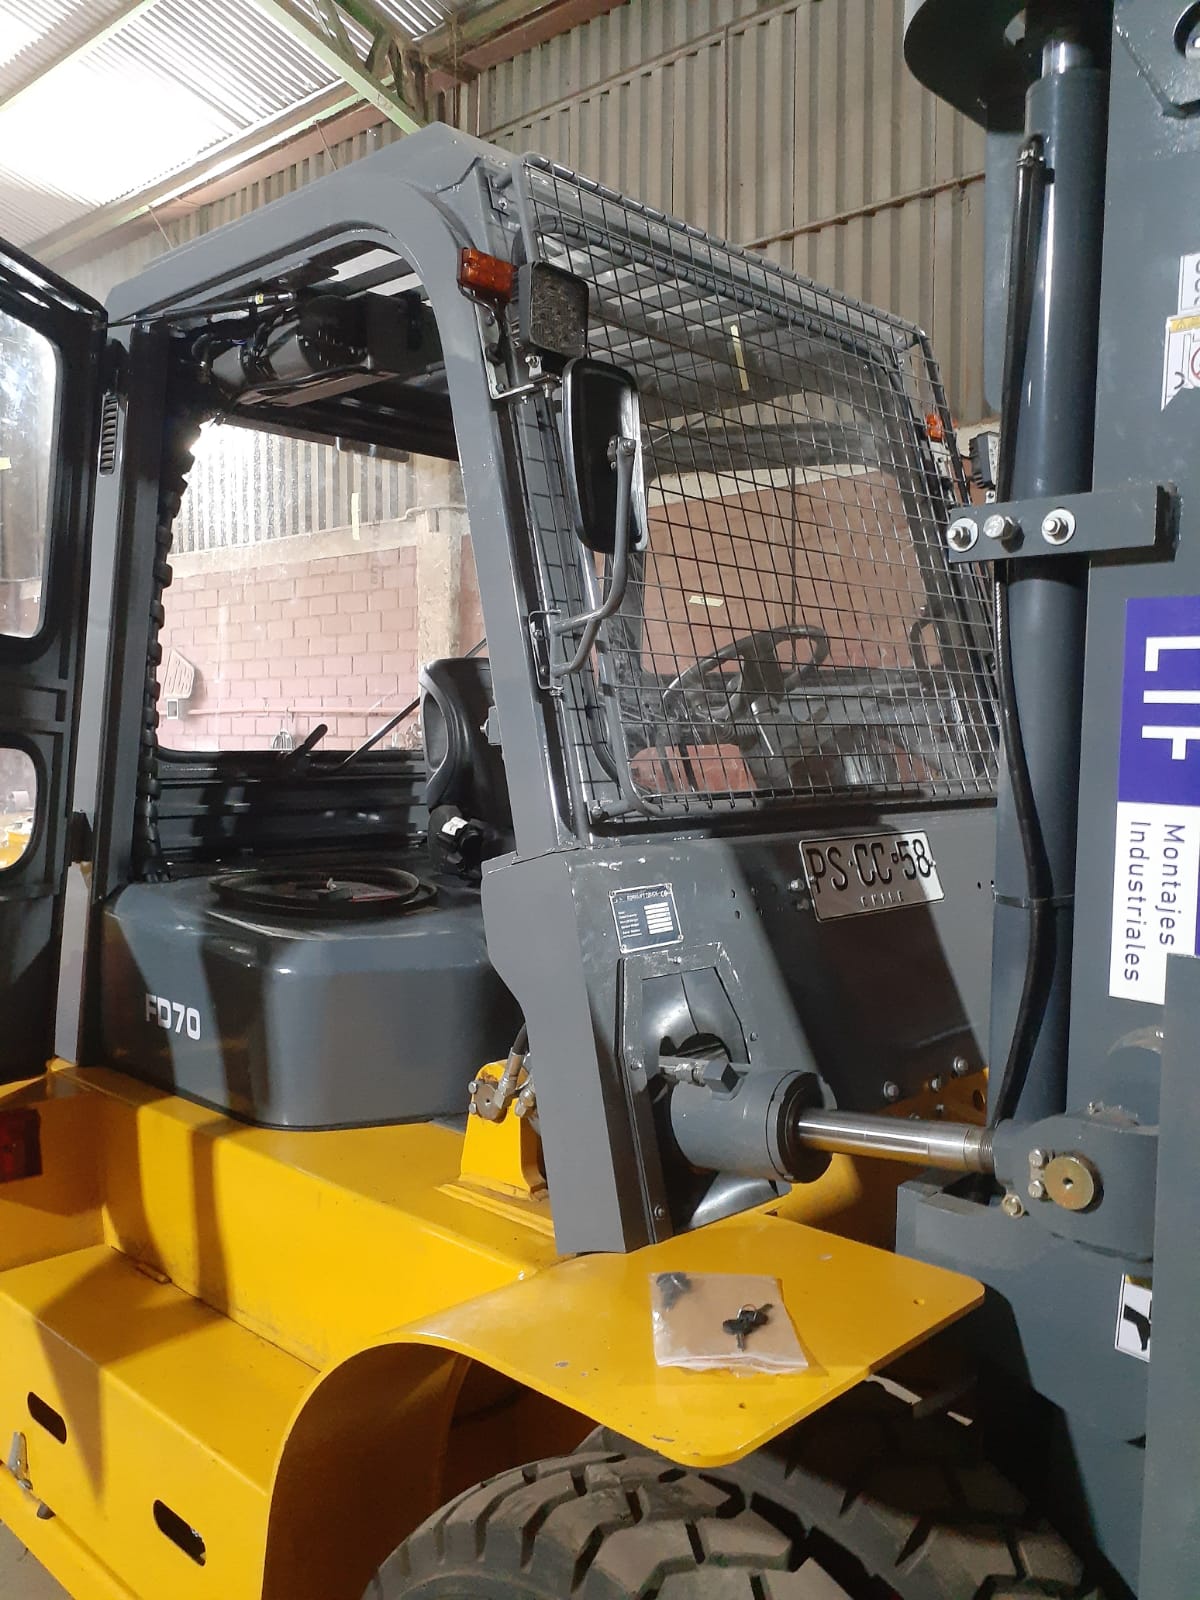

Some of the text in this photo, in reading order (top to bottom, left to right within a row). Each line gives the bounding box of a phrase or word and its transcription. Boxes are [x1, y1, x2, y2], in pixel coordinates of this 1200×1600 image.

[1124, 821, 1152, 982] Industriales
[1155, 823, 1186, 946] Montajes
[145, 992, 201, 1041] FD70
